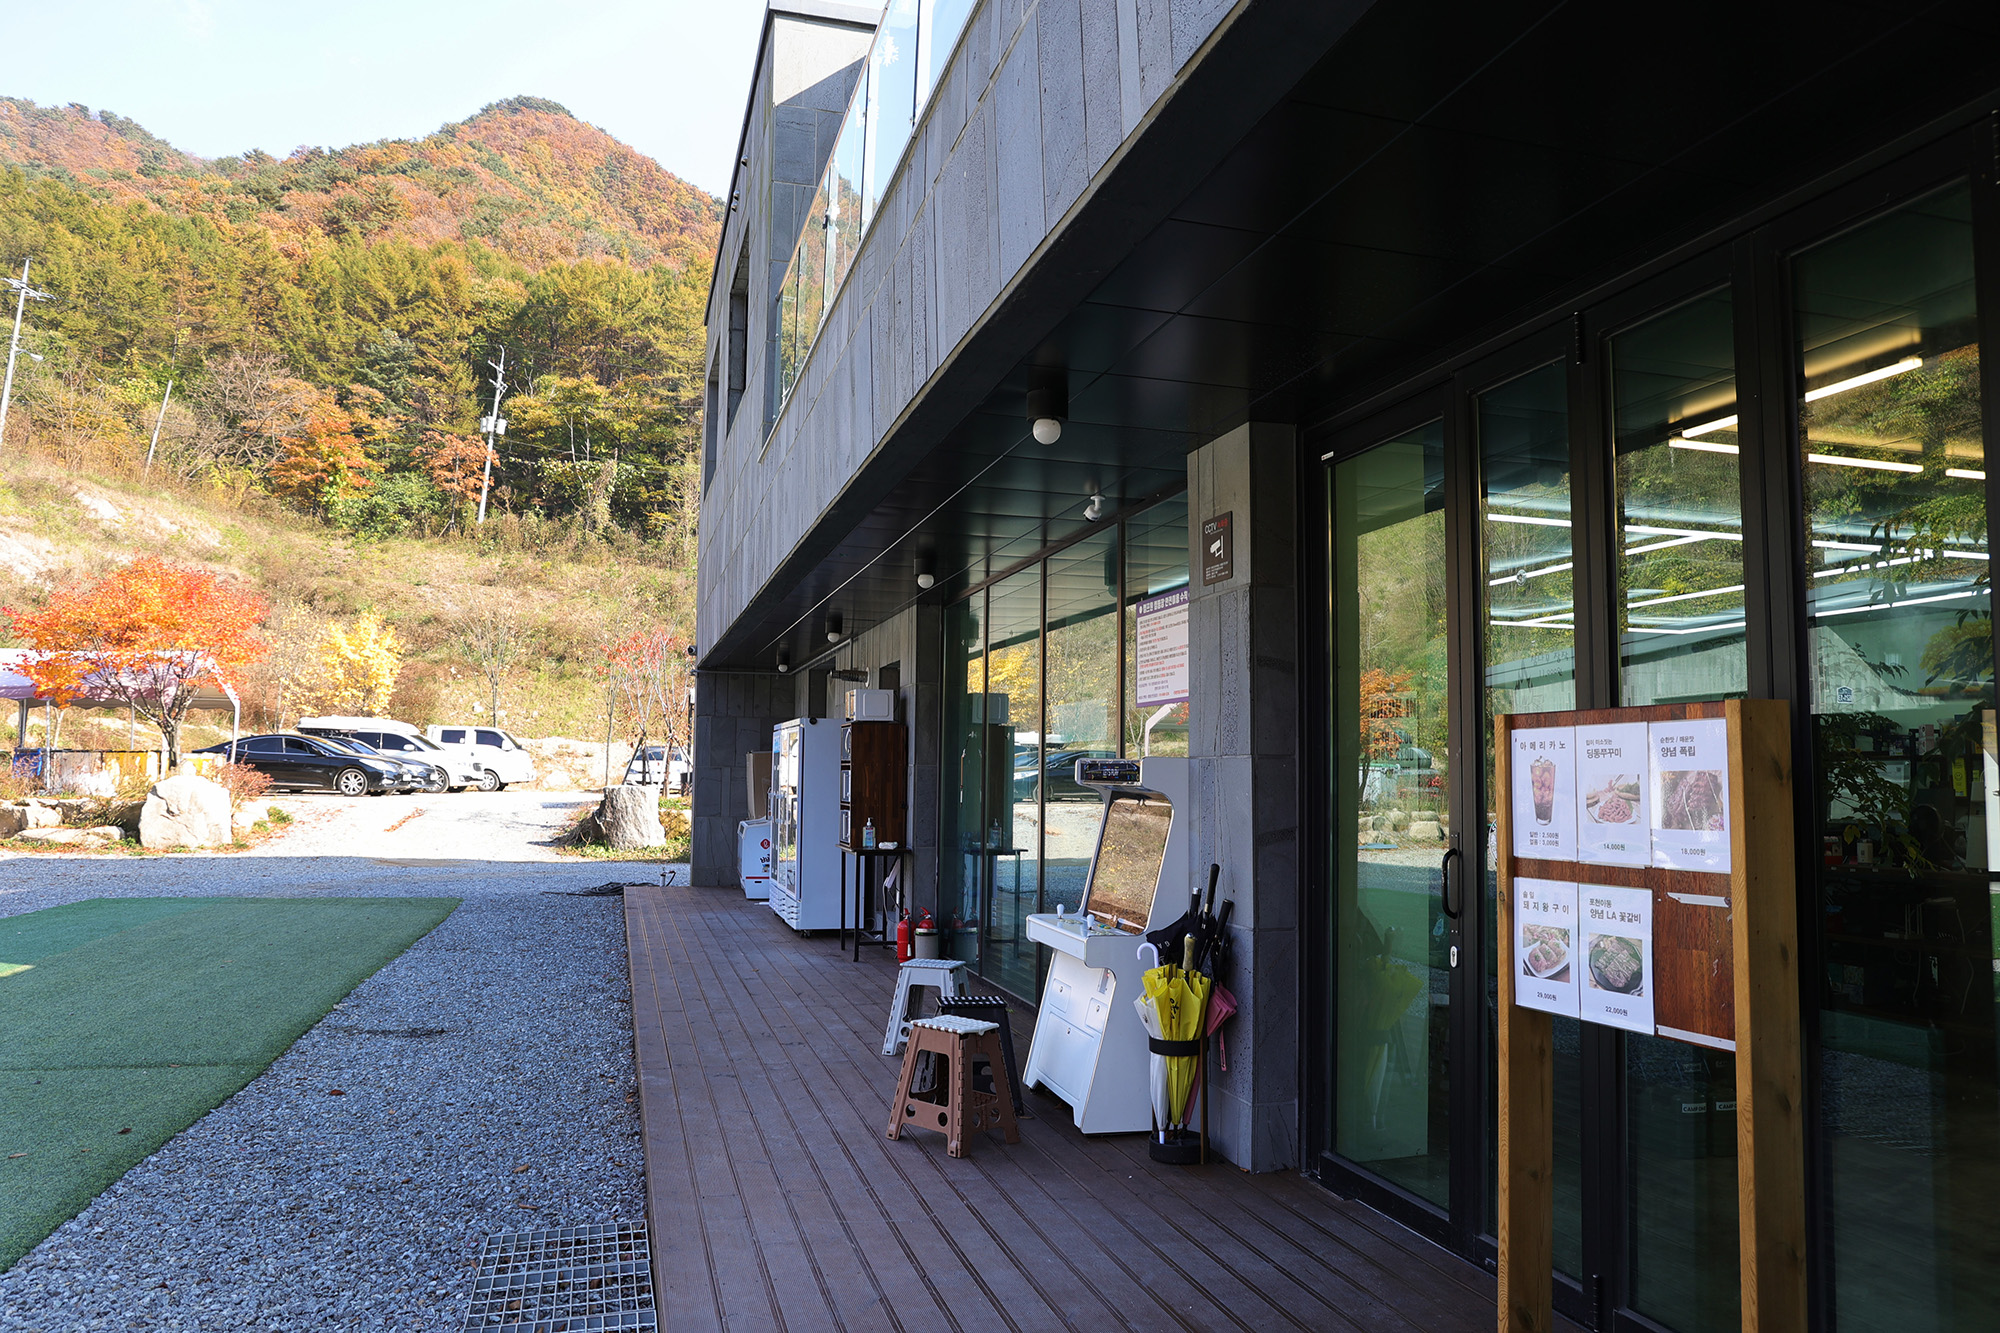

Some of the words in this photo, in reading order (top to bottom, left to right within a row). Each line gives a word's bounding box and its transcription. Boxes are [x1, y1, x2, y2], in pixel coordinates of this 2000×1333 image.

[1204, 521, 1217, 534] CCTV
[1661, 746, 1676, 758] 양념
[1603, 843, 1625, 851] 14,000원
[1681, 848, 1706, 856] 18,000원
[1590, 908, 1604, 920] 양념
[1606, 911, 1617, 920] LA
[1619, 911, 1641, 924] 꽃갈비
[1605, 1006, 1628, 1016] 22,000원
